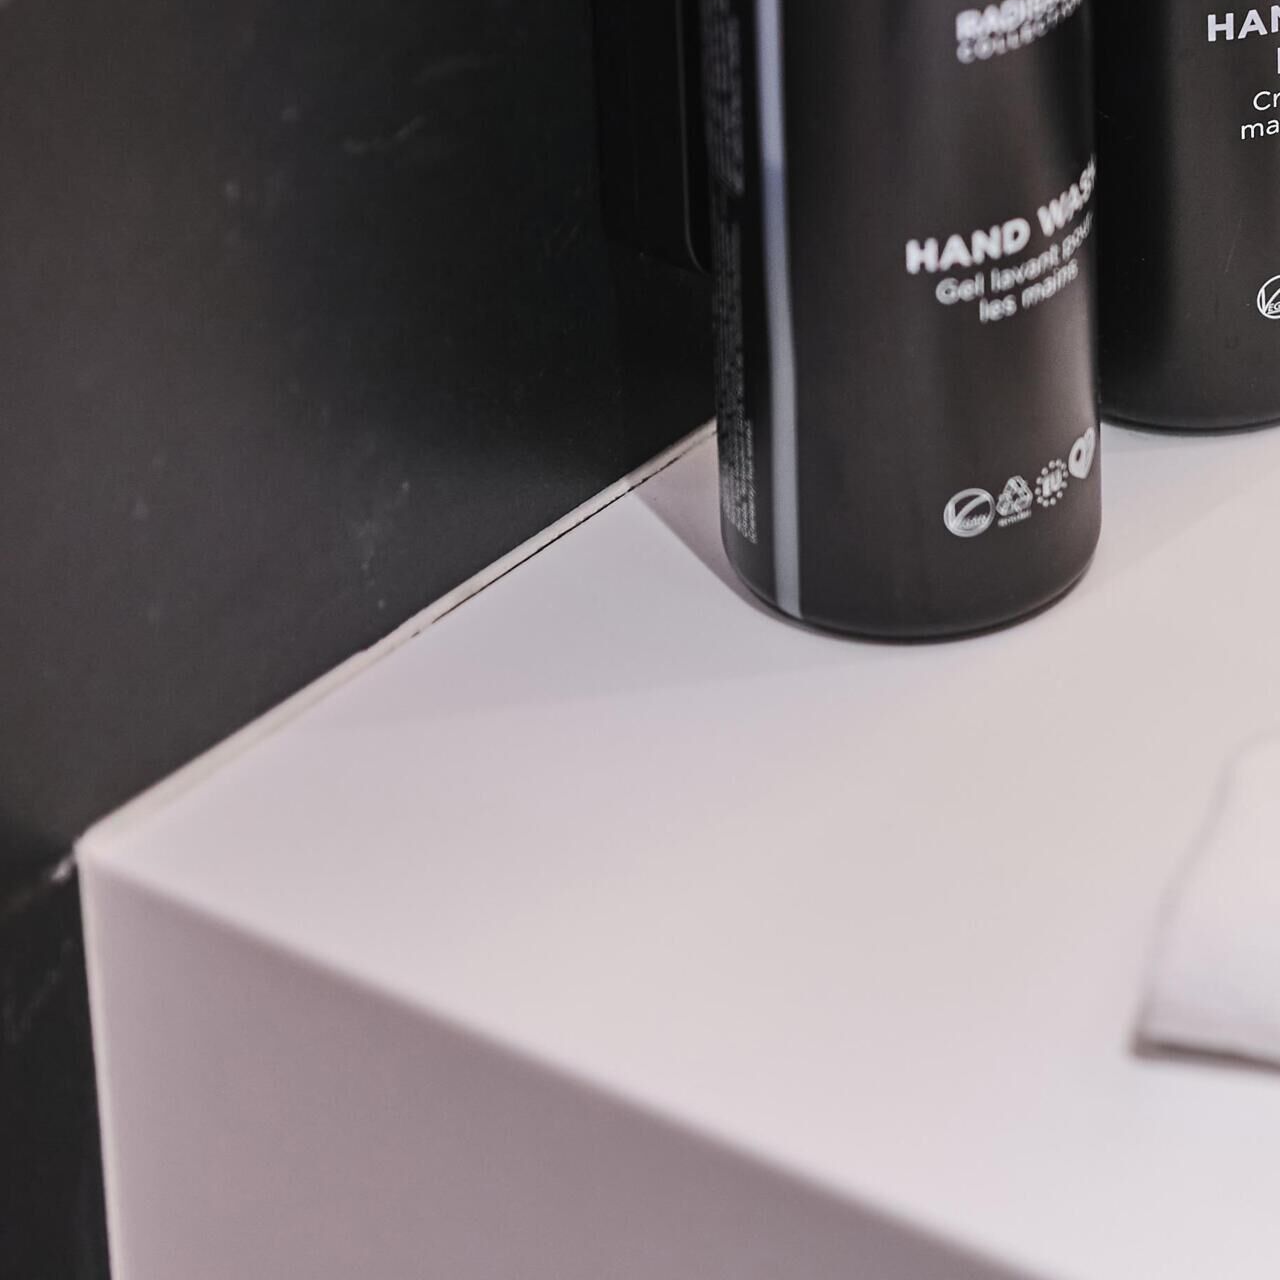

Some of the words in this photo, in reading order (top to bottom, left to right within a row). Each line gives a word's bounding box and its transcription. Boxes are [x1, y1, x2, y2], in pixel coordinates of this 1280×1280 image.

[905, 217, 1031, 275] HAND
[935, 271, 985, 305] Gel
[979, 293, 1018, 324] les
[1021, 257, 1079, 309] mains
